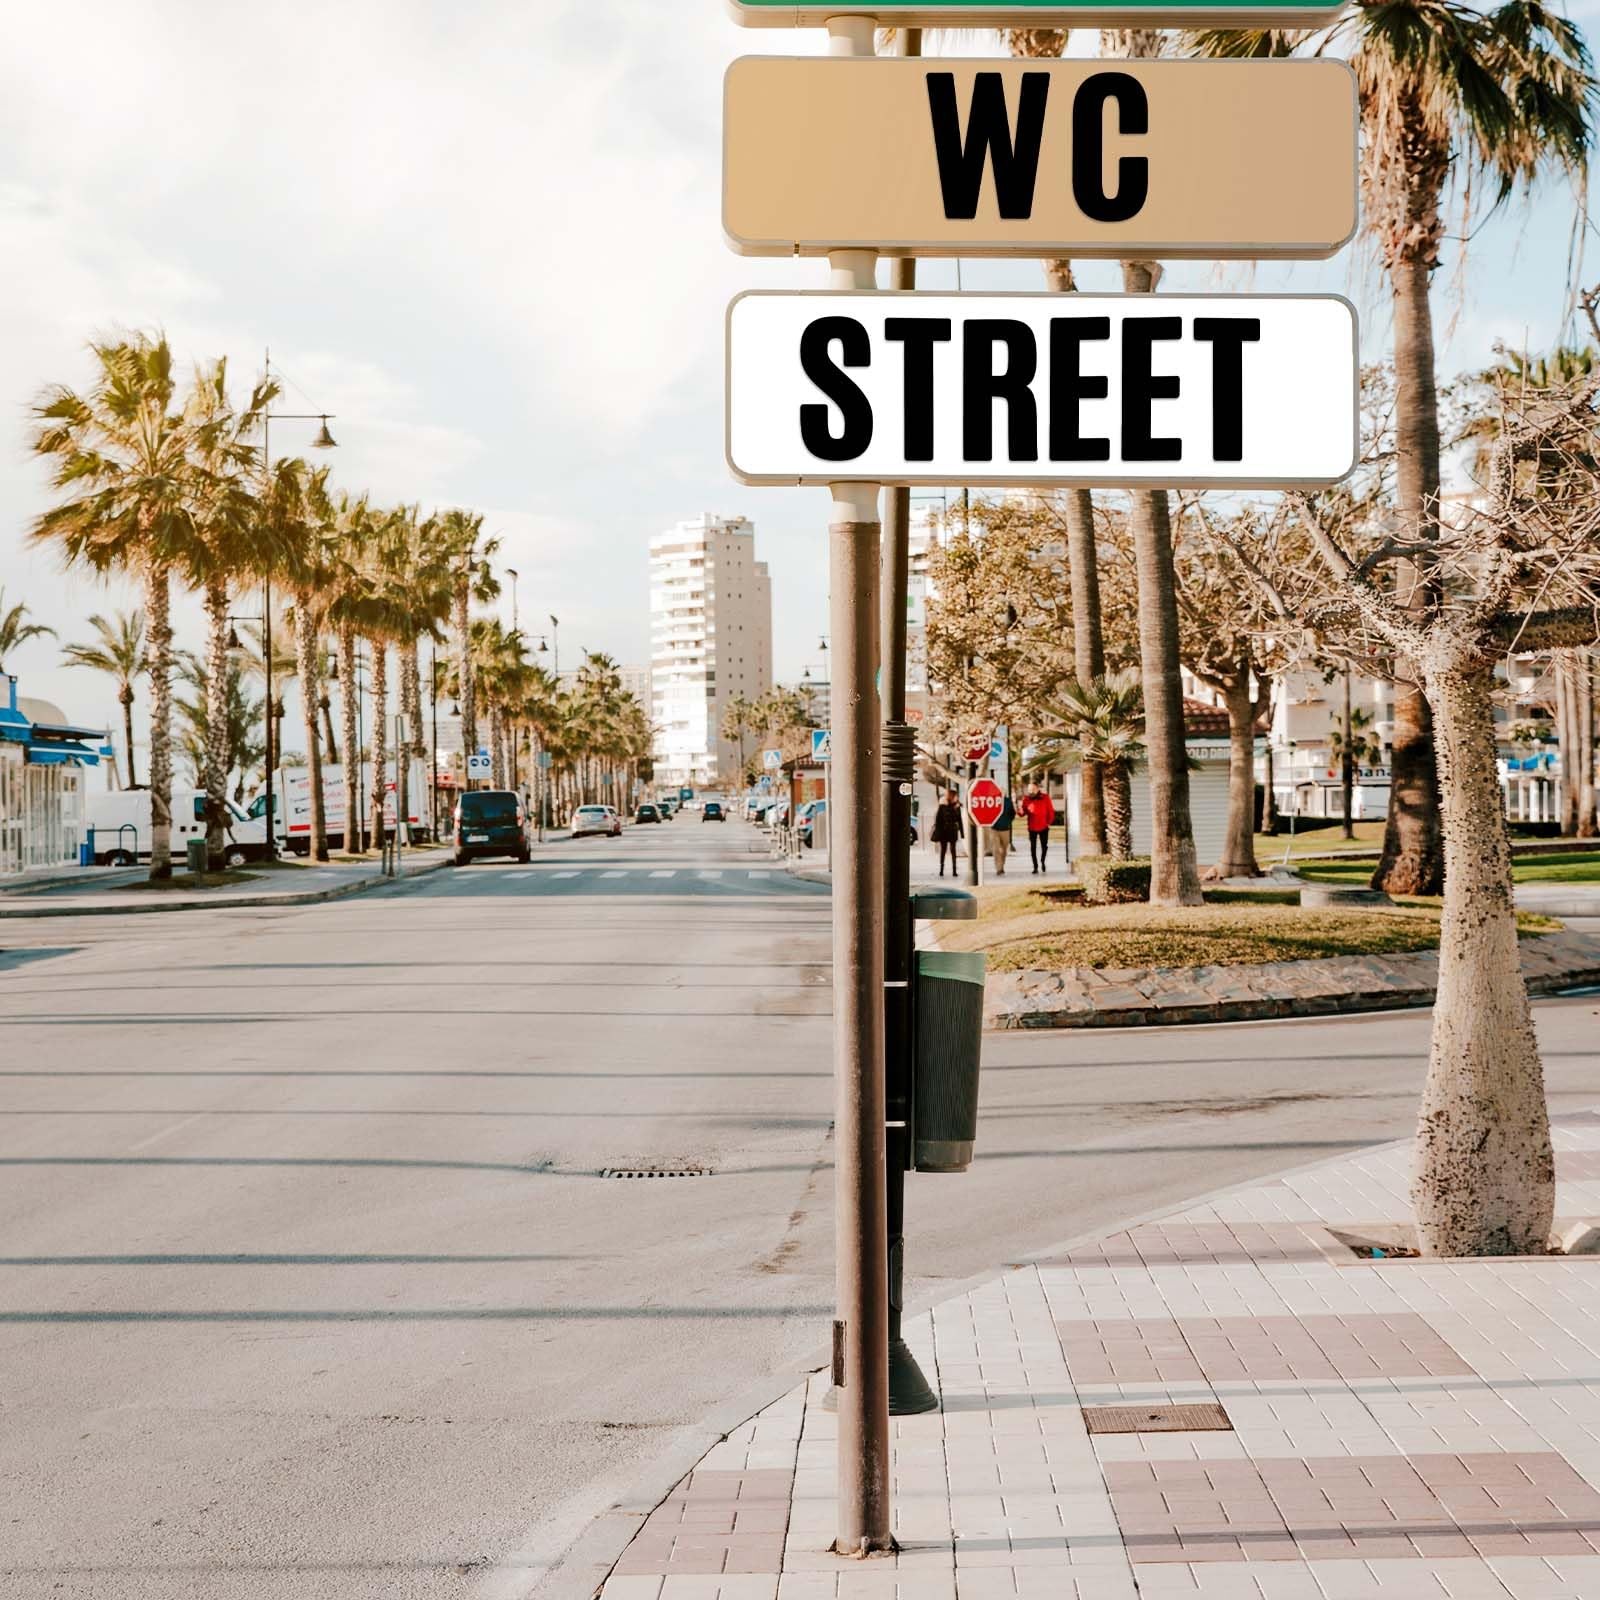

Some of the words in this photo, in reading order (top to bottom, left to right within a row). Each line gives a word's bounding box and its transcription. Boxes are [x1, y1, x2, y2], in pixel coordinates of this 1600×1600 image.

[926, 72, 1149, 222] WC
[800, 316, 1261, 462] STREET
[972, 796, 1002, 808] STOP
